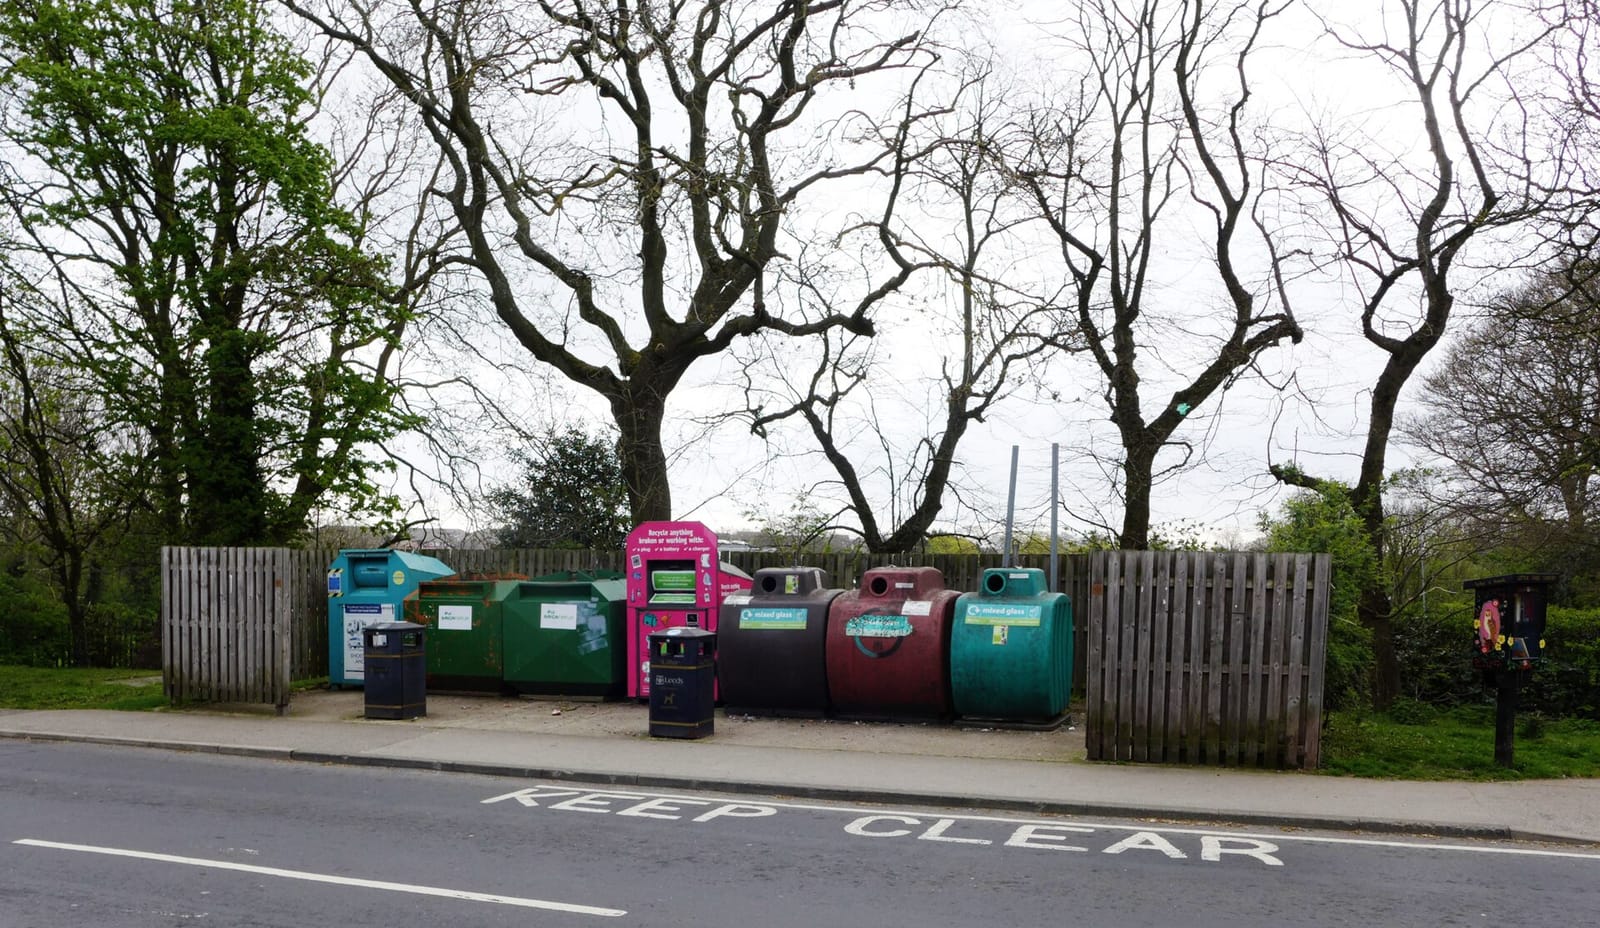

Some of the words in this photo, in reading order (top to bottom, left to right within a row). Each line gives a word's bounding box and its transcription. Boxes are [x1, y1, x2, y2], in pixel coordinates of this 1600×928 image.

[648, 529, 668, 537] Recycle
[669, 529, 693, 537] anything
[665, 537, 687, 545] working
[775, 611, 792, 620] glass
[982, 607, 1005, 615] mixed
[1006, 607, 1025, 616] glass
[664, 676, 684, 685] Leeds
[480, 788, 777, 822] KEEP
[843, 815, 1285, 866] CLEAR
